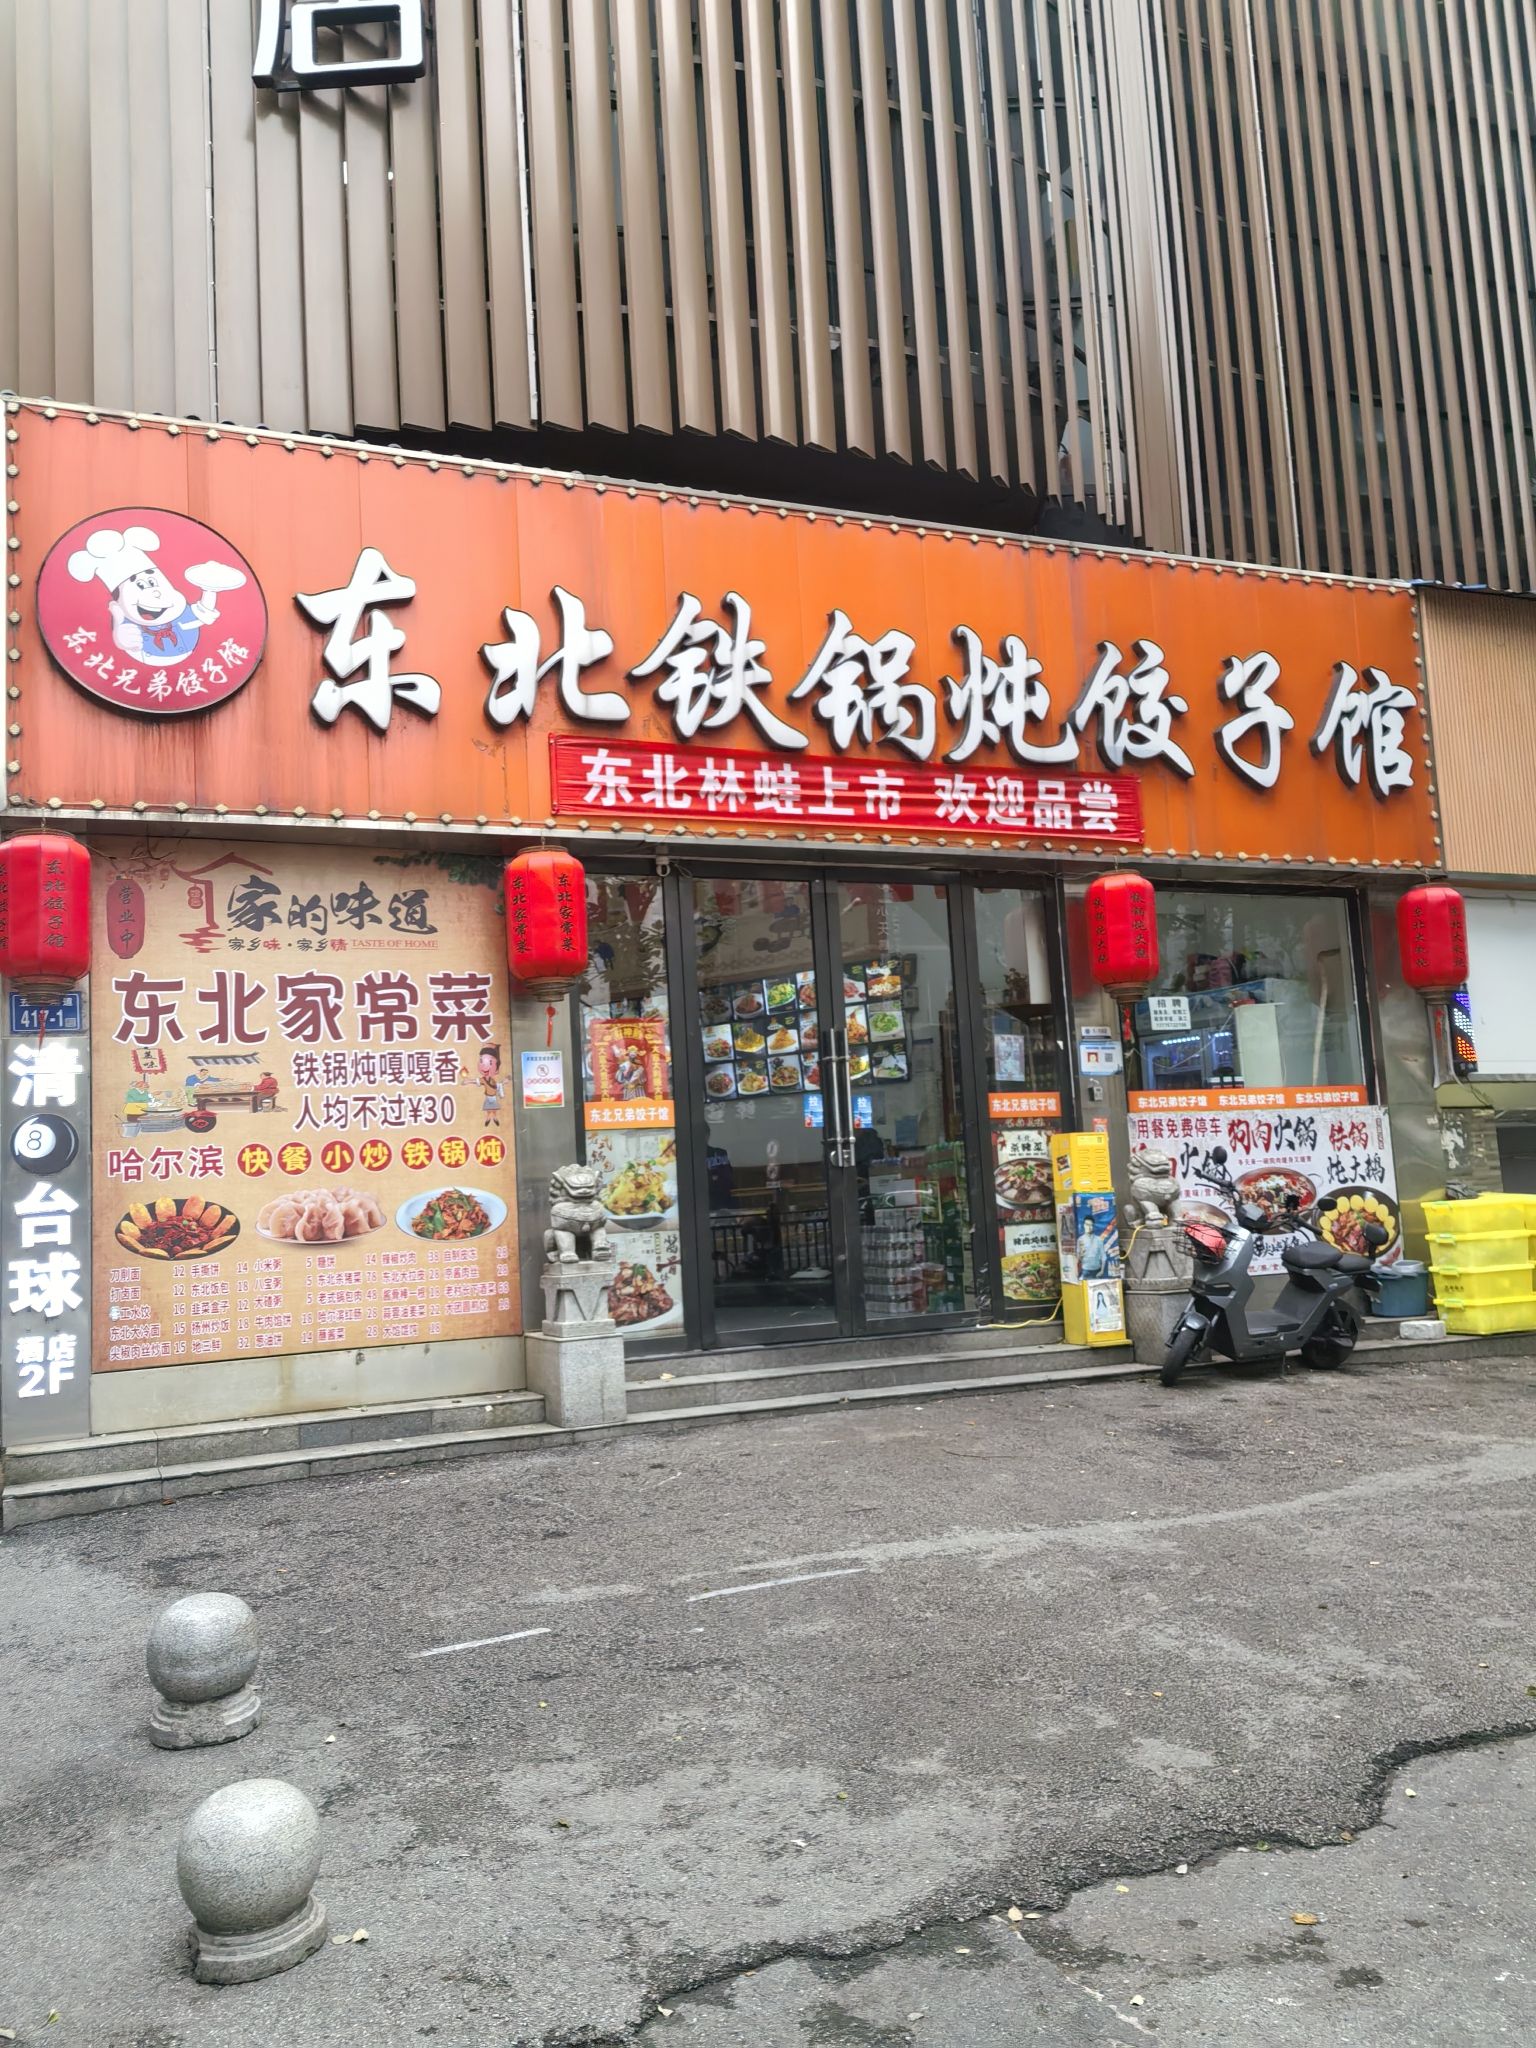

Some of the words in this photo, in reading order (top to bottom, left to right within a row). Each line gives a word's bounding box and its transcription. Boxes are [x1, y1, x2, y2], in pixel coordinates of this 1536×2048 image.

[62, 626, 250, 702] 东北兄弟饺子馆
[294, 547, 1417, 798] 东北铁锅炖饺子馆
[581, 747, 905, 820] 东北林蛙上市
[934, 776, 1120, 832] 欢迎品尝
[119, 887, 136, 953] 营业中
[227, 875, 438, 935] 家的味道
[557, 873, 576, 952] 东北家常菜
[353, 939, 385, 948] TASTE
[387, 939, 402, 948] OF
[405, 938, 438, 948] HOME
[112, 970, 494, 1046] 东北家常菜
[9, 1044, 83, 1107] 清
[292, 1050, 459, 1088] 铁锅炖嘎嘎香
[294, 1094, 454, 1131] 人均不过¥30
[1137, 1117, 1223, 1139] 用餐免费停车
[26, 1129, 42, 1152] 8
[1228, 1115, 1318, 1155] 狗肉火锅
[1328, 1121, 1370, 1152] 铁锅
[108, 1144, 224, 1182] 哈尔滨
[1327, 1154, 1385, 1184] 炖大鹅
[8, 1181, 82, 1317] 台球
[174, 1265, 186, 1277] 12
[174, 1285, 186, 1297] 12
[110, 1306, 151, 1322] 工水饺
[16, 1333, 77, 1365] 酒店
[18, 1359, 74, 1398] 2F
